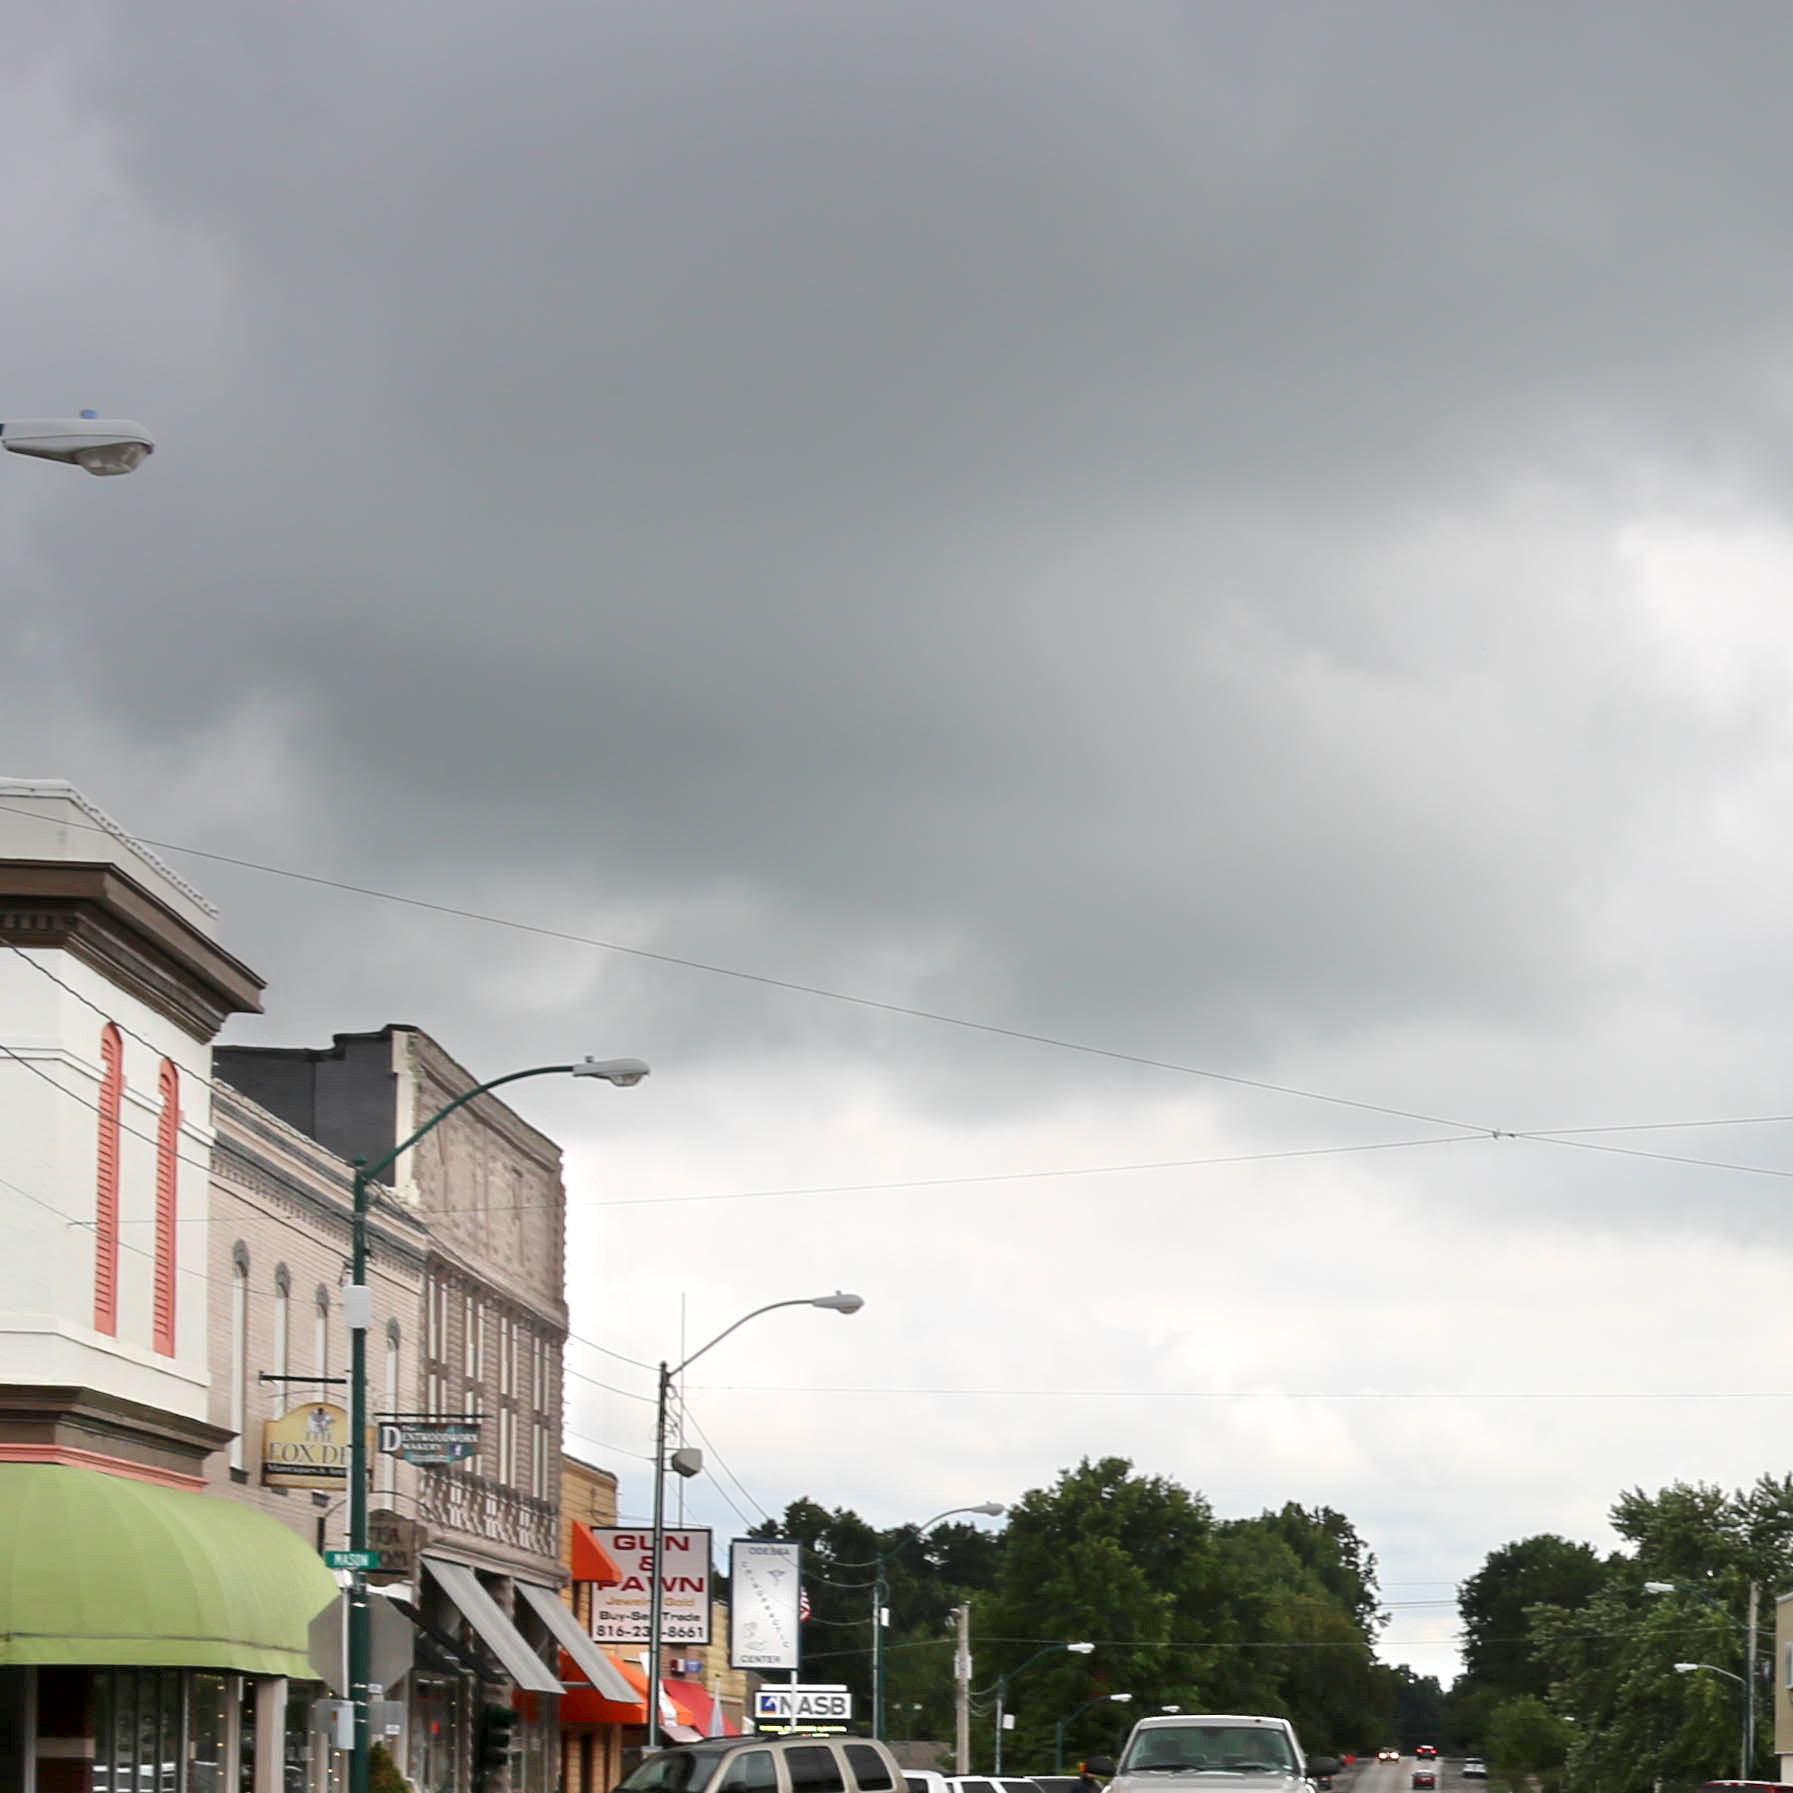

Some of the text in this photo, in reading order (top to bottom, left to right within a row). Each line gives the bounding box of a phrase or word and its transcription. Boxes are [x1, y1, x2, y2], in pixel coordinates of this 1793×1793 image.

[270, 1442, 314, 1464] FOX
[333, 1553, 369, 1567] MASON
[597, 1625, 704, 1638] 816-23-8661
[740, 1655, 782, 1664] CENTER
[779, 1696, 846, 1716] NASB
